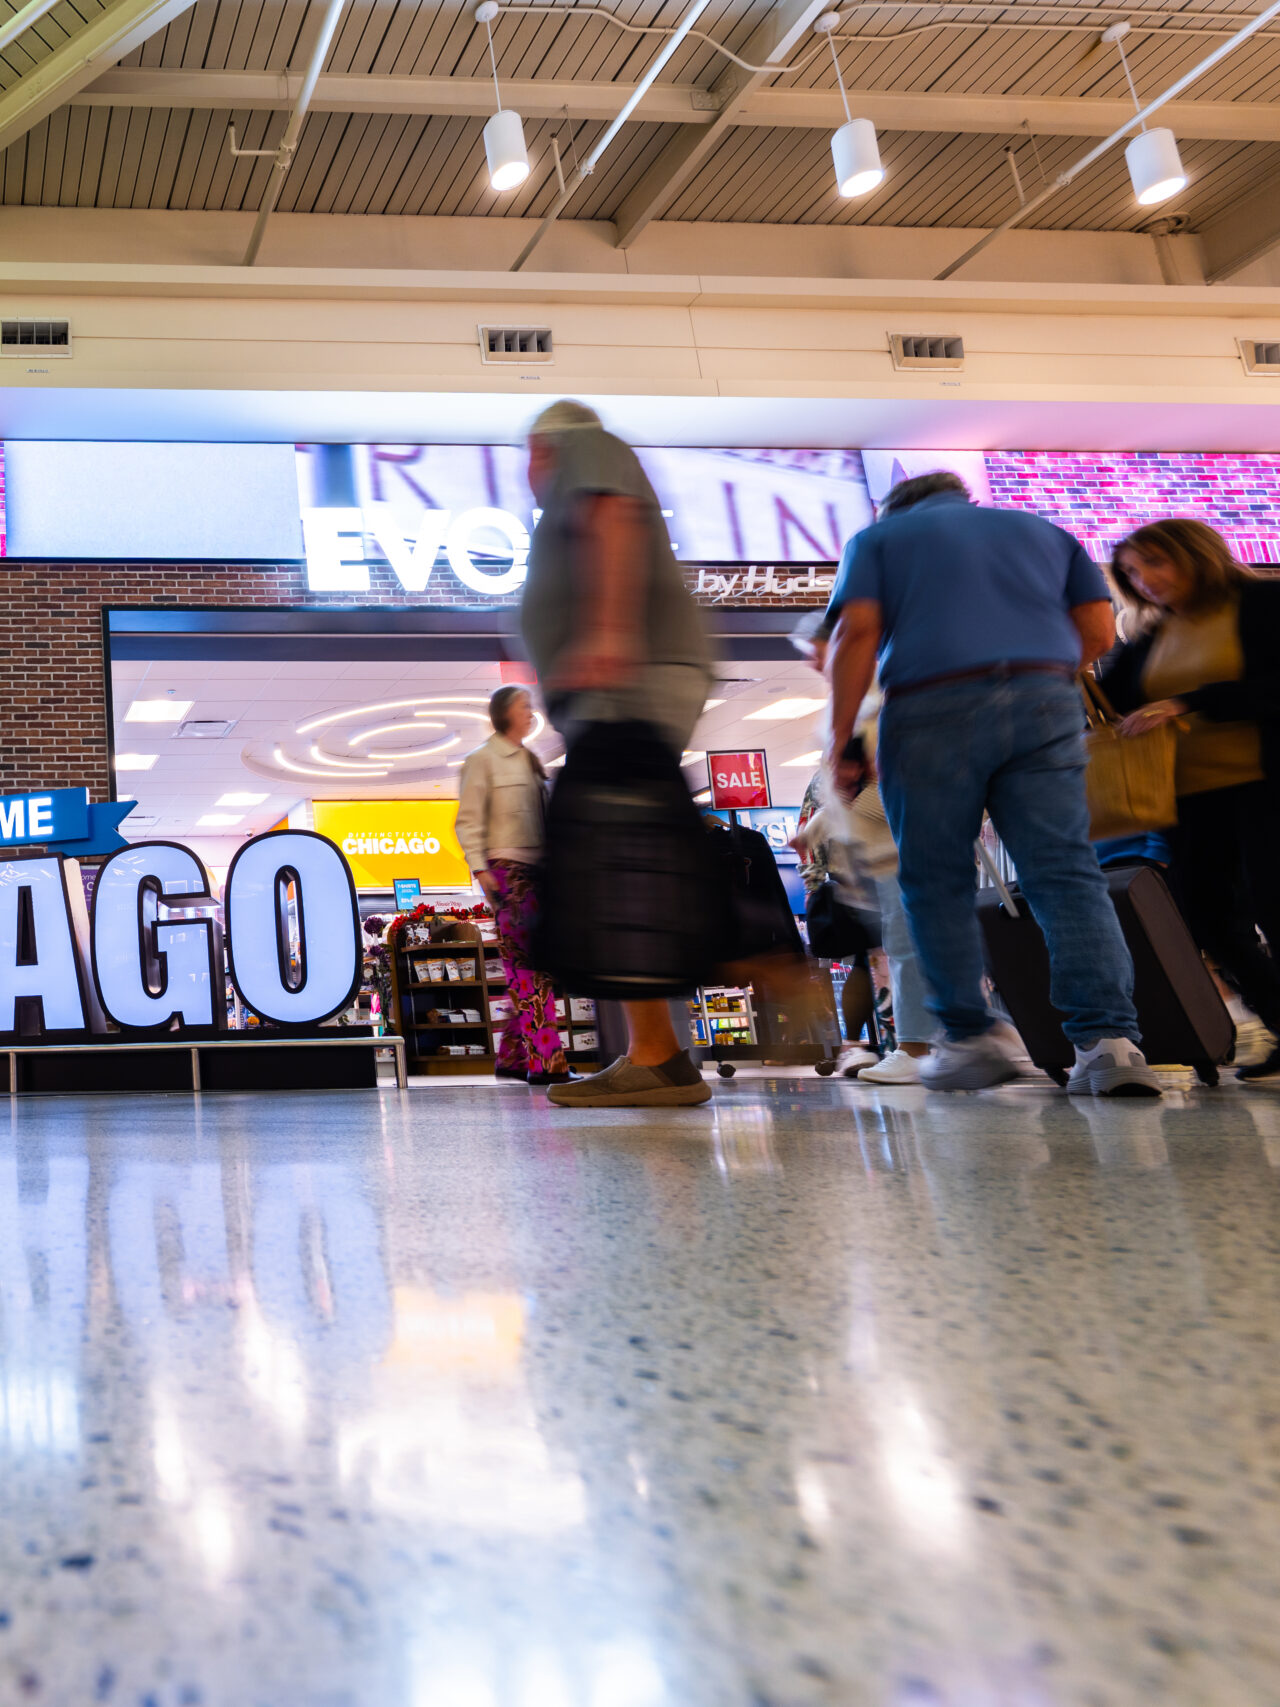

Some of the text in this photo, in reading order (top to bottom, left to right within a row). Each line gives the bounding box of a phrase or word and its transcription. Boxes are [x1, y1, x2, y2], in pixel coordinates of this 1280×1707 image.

[697, 565, 837, 597] by Huds
[716, 771, 762, 789] SALE
[342, 837, 441, 855] CHICAGO
